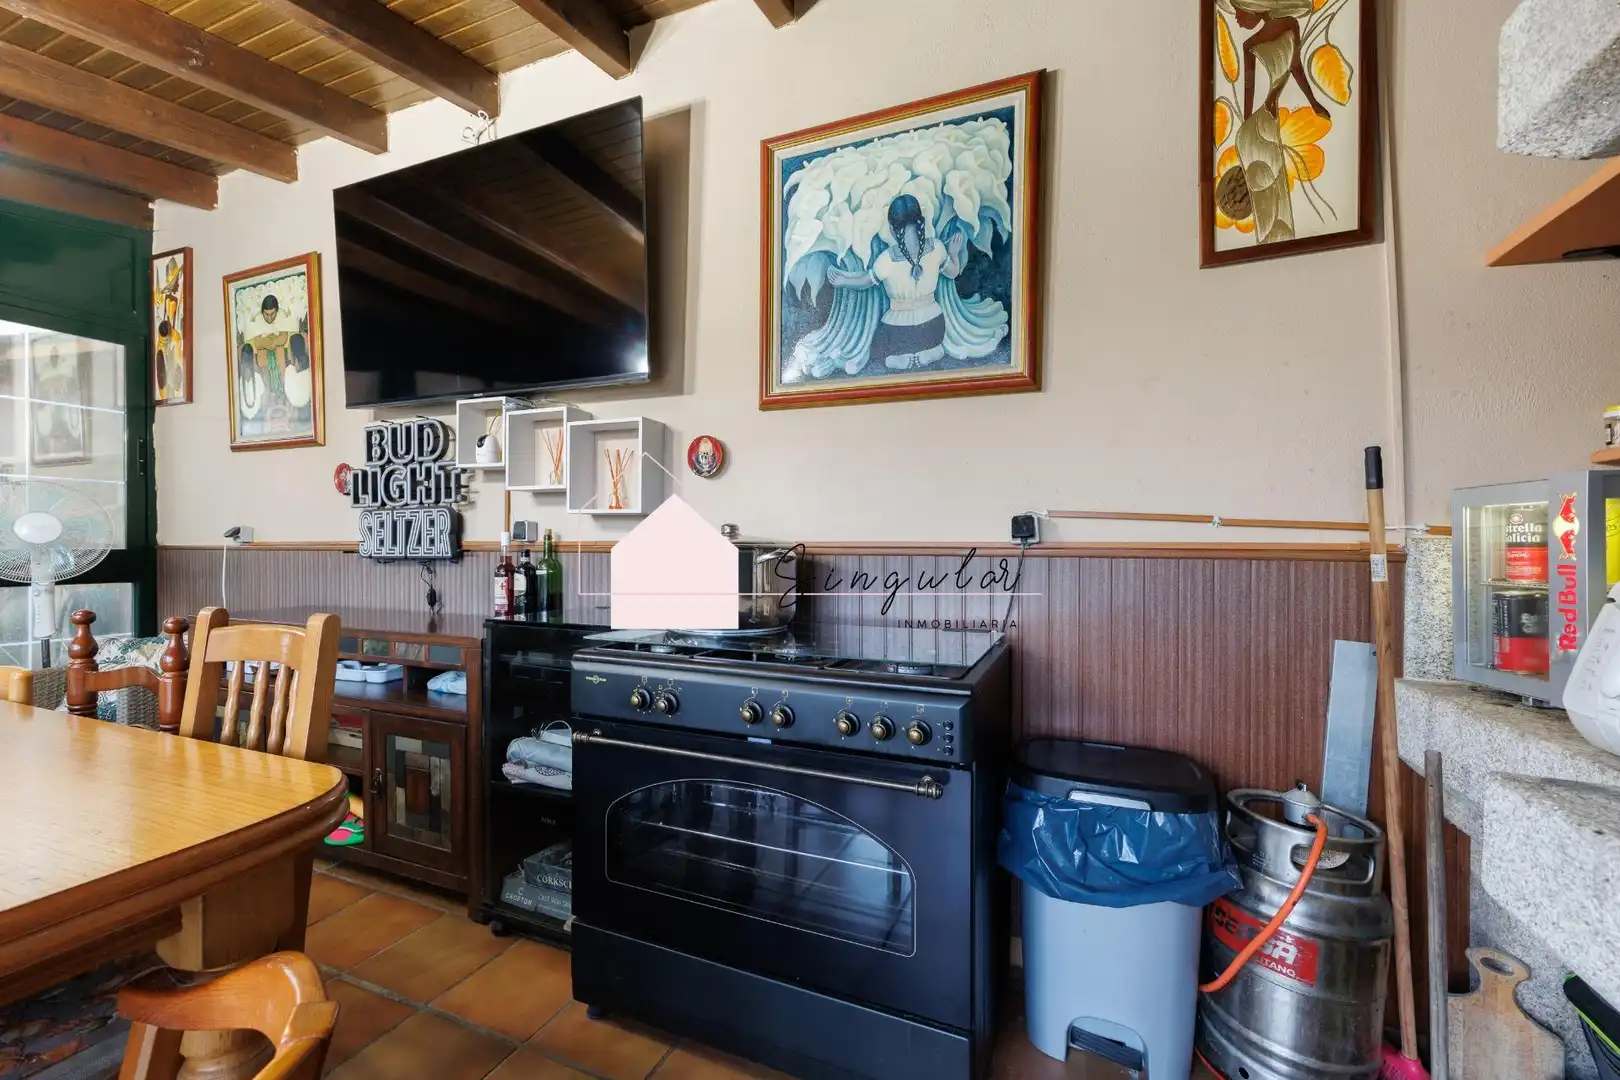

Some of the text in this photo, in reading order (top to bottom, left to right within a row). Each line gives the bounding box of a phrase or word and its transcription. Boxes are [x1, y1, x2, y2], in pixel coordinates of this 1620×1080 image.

[364, 418, 447, 466] BUD
[351, 461, 462, 508] LIGHT
[359, 508, 453, 558] SELTZER
[1504, 533, 1541, 543] alicia
[1556, 565, 1577, 650] Red Bull
[1264, 957, 1297, 978] TANO
